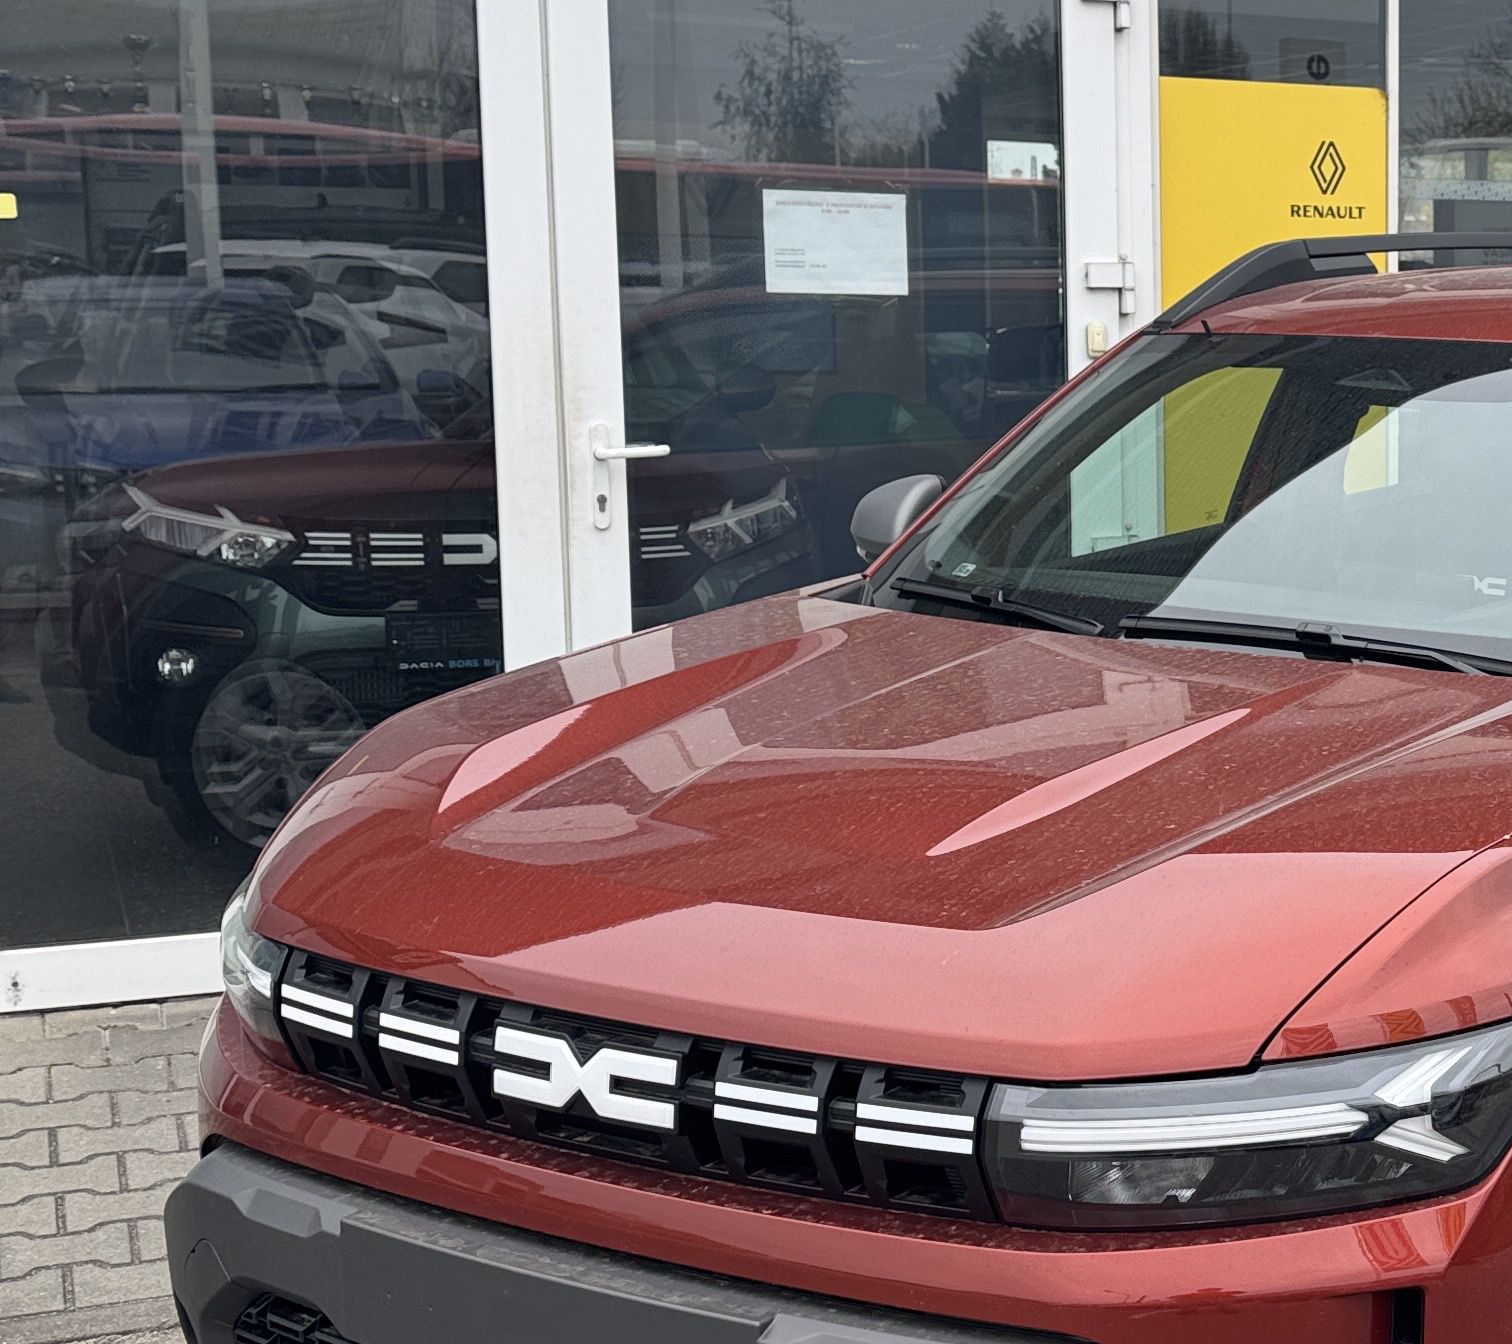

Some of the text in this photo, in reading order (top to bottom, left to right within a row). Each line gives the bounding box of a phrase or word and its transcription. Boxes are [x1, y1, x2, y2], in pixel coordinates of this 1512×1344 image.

[1290, 204, 1366, 219] RENAULT
[399, 661, 444, 670] DACIA
[448, 658, 480, 669] BORS
